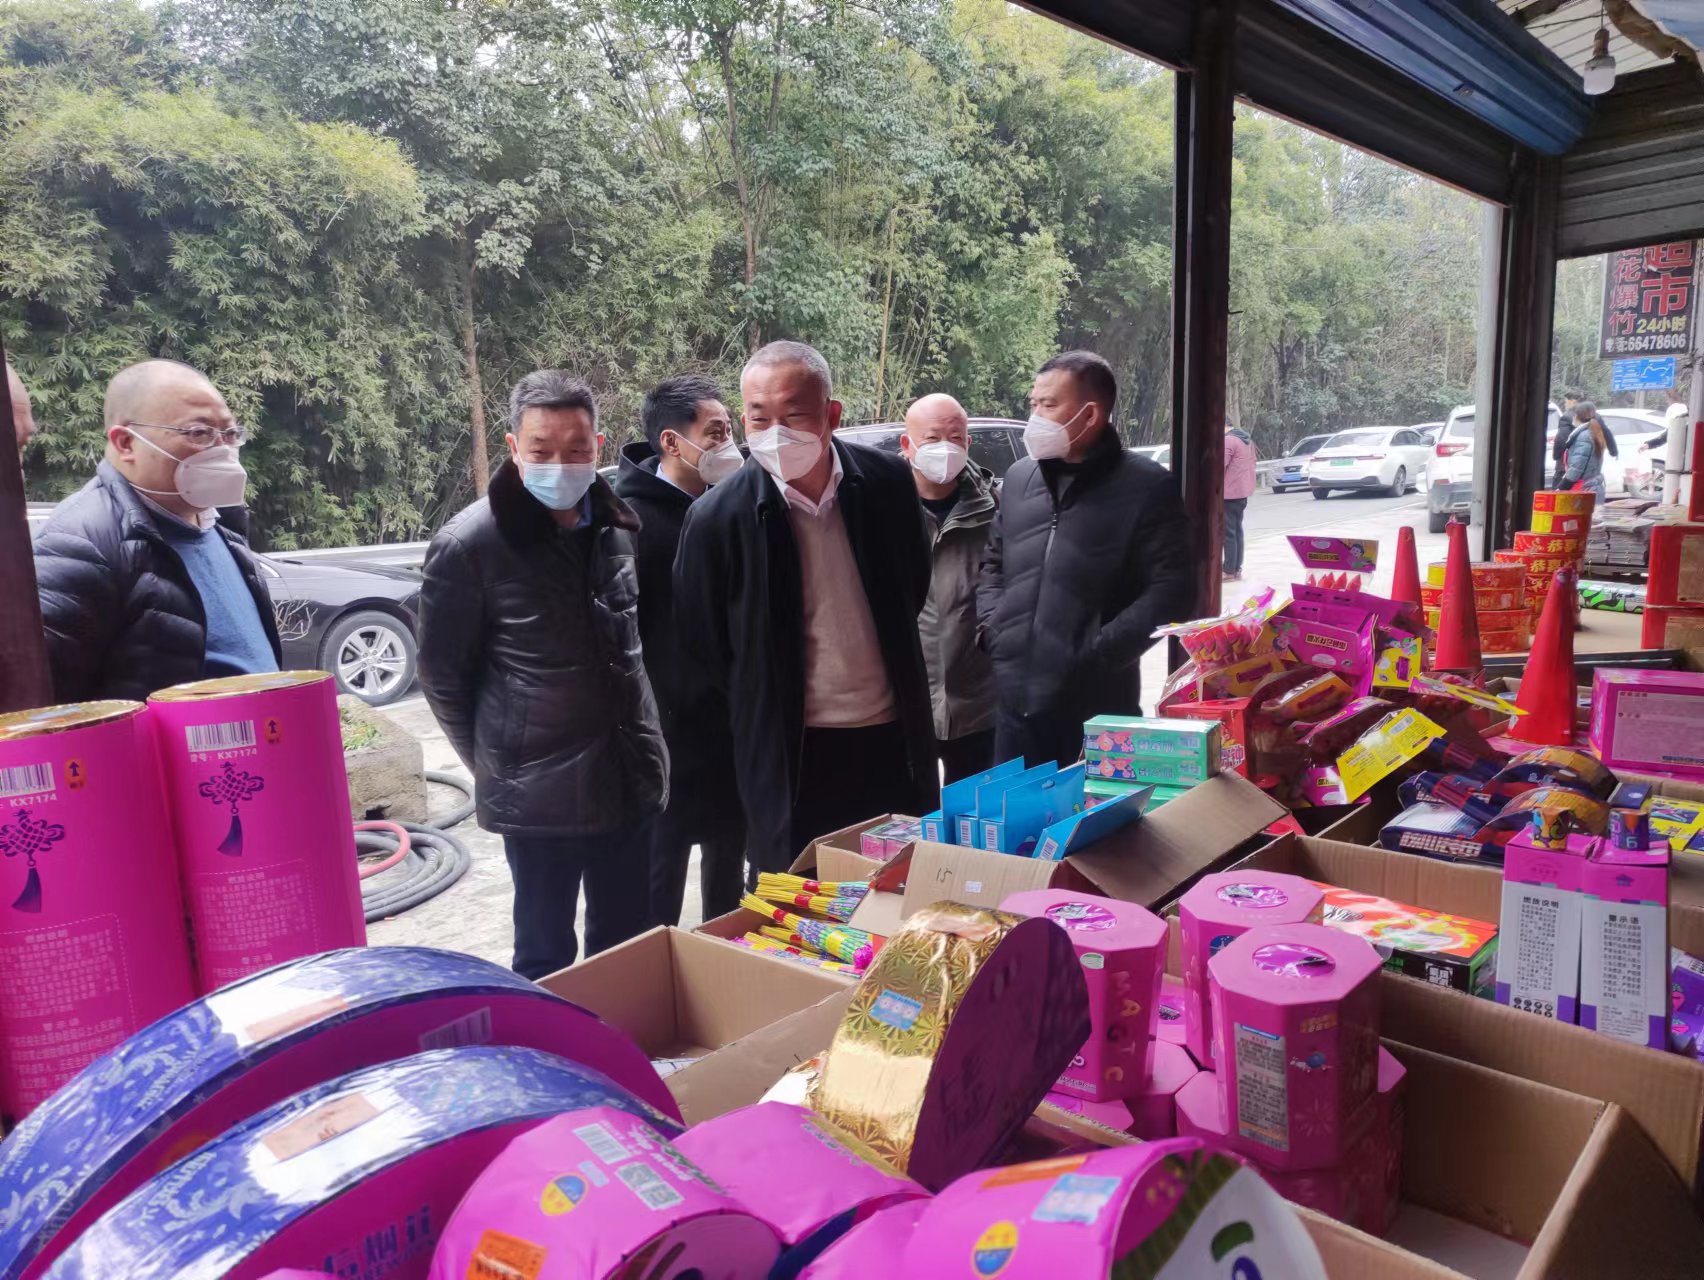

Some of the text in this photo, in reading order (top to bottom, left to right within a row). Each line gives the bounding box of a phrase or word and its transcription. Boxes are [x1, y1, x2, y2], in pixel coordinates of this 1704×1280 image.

[1636, 315, 1687, 334] 24小时
[217, 747, 257, 760] KX7174
[10, 793, 57, 807] KX7174
